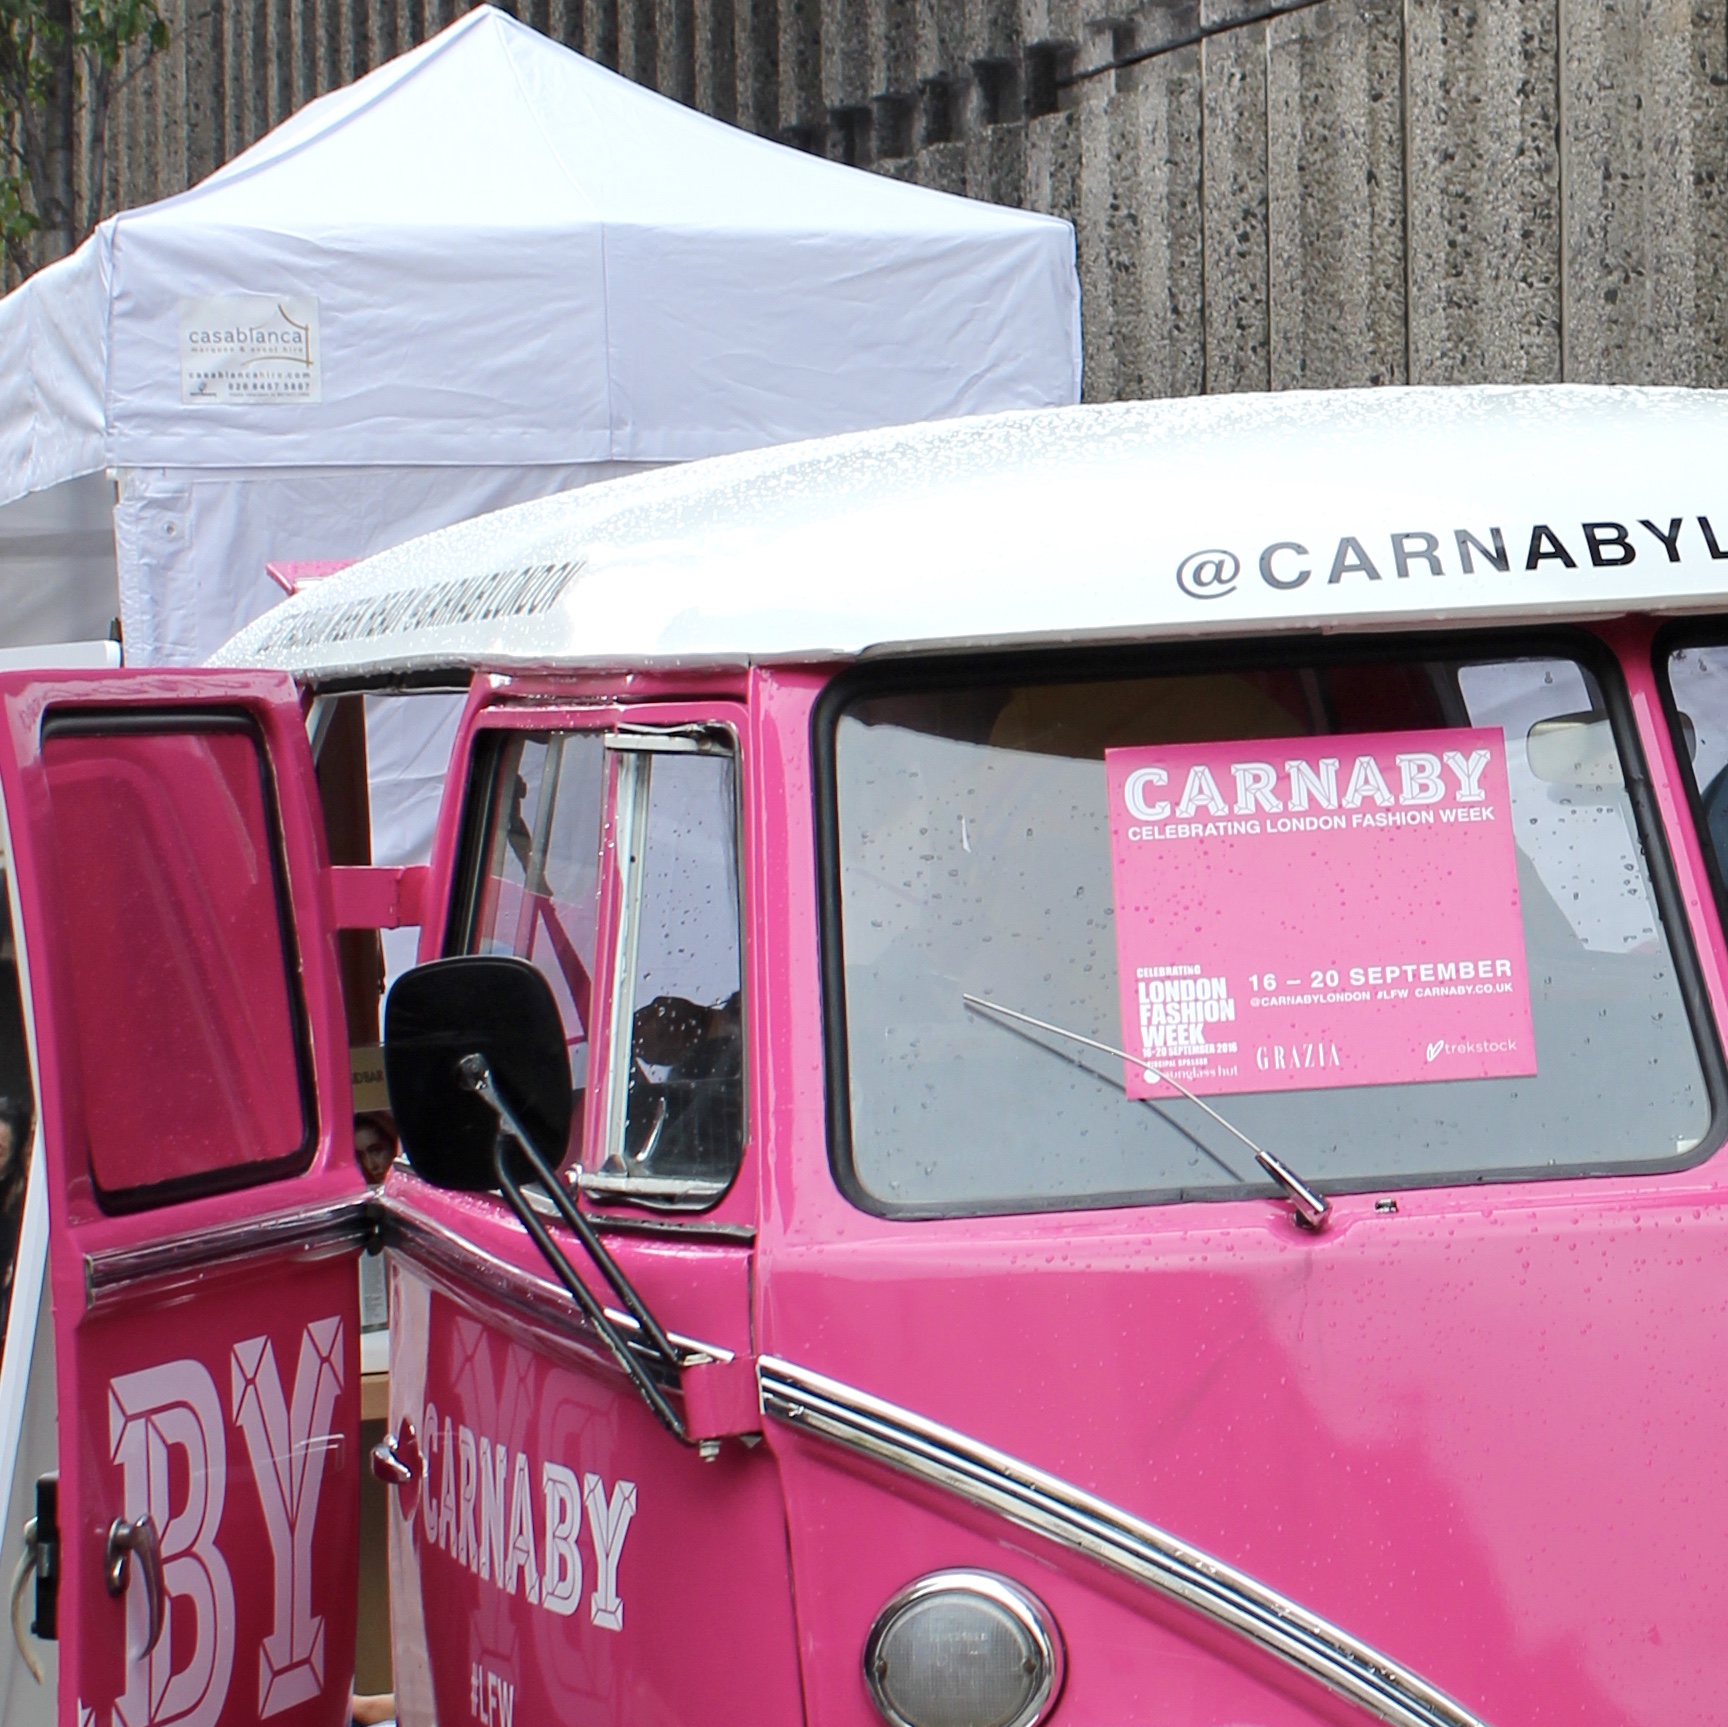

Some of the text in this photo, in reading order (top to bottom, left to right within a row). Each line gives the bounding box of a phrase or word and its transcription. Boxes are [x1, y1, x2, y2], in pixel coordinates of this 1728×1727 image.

[189, 327, 303, 345] casablanca
[1123, 749, 1491, 822] CARNABY
[1127, 806, 1495, 842] CELEBRATING LONDON FASHION WEEK
[1136, 964, 1201, 979] CELEBRATING
[1249, 973, 1277, 992] 16
[1310, 969, 1340, 989] 20
[1349, 959, 1512, 986] SEPTEMBER
[1138, 977, 1228, 1004] LONDON
[1250, 982, 1513, 1007] @CARNABYLONDON #LFW CARNABY.CO.UK
[1139, 998, 1236, 1026] FASHION
[1140, 1023, 1206, 1048] WEEK
[1444, 1038, 1517, 1055] trekstock
[1168, 1043, 1216, 1056] SEPTEMBER
[1256, 1042, 1340, 1071] GRAZIA
[1217, 1065, 1238, 1077] hut
[421, 1402, 637, 1631] CARNABY
